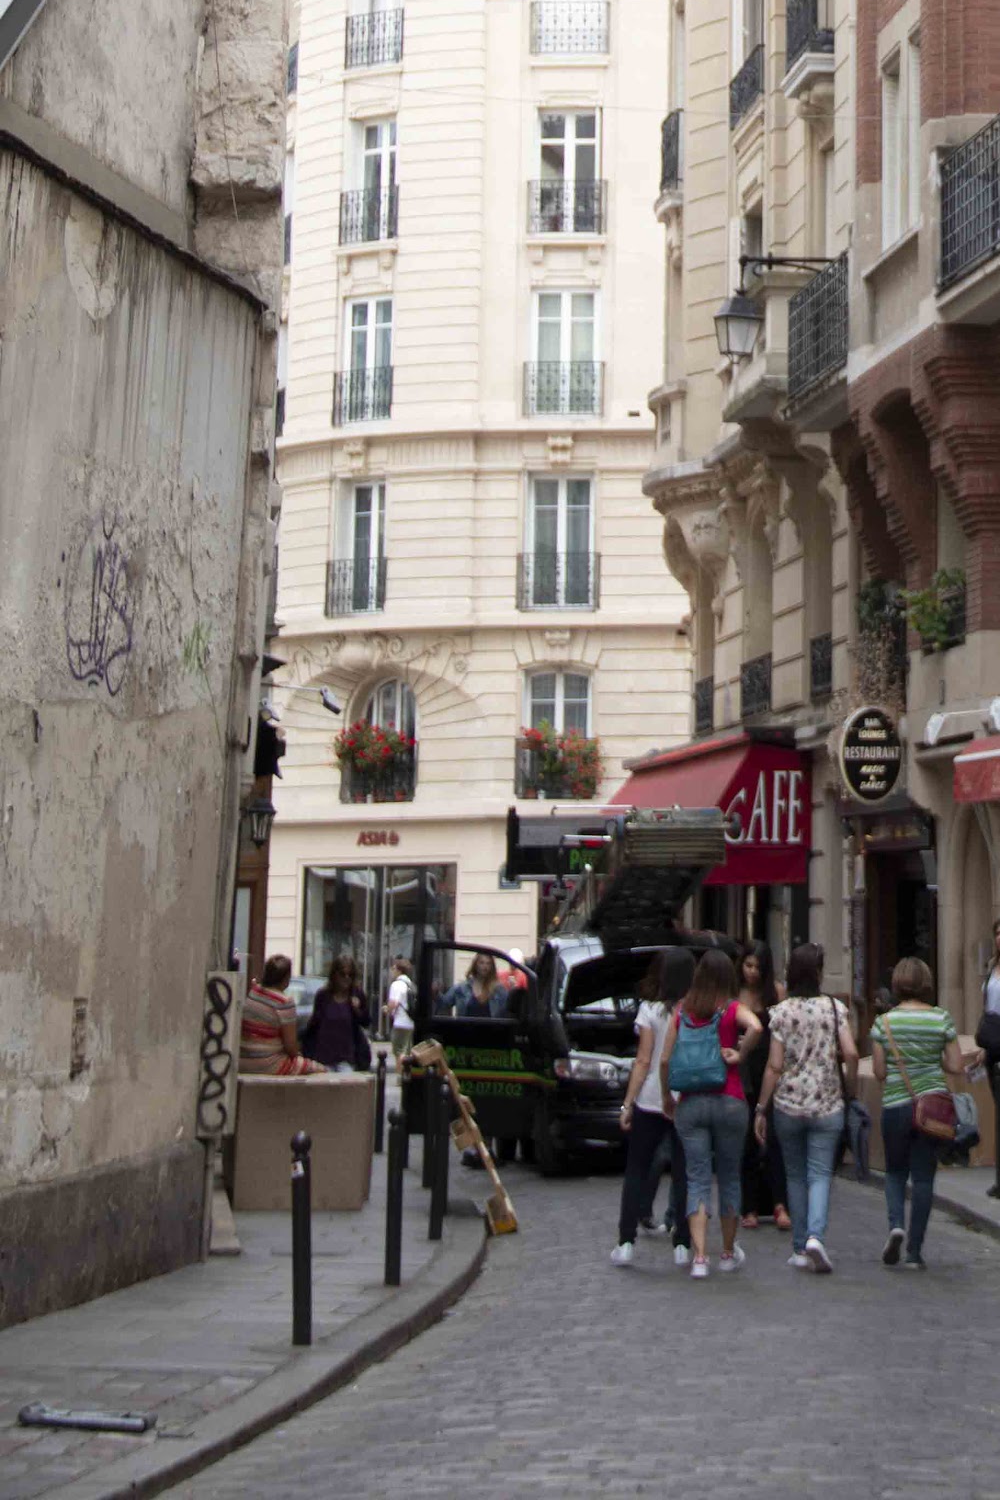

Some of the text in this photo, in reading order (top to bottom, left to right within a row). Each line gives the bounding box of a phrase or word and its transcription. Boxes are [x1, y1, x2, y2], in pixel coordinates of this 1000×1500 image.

[858, 729, 887, 739] LOUNGE
[844, 745, 900, 759] RESTAURANT
[859, 764, 887, 773] MUSIC
[859, 780, 887, 789] DANCE
